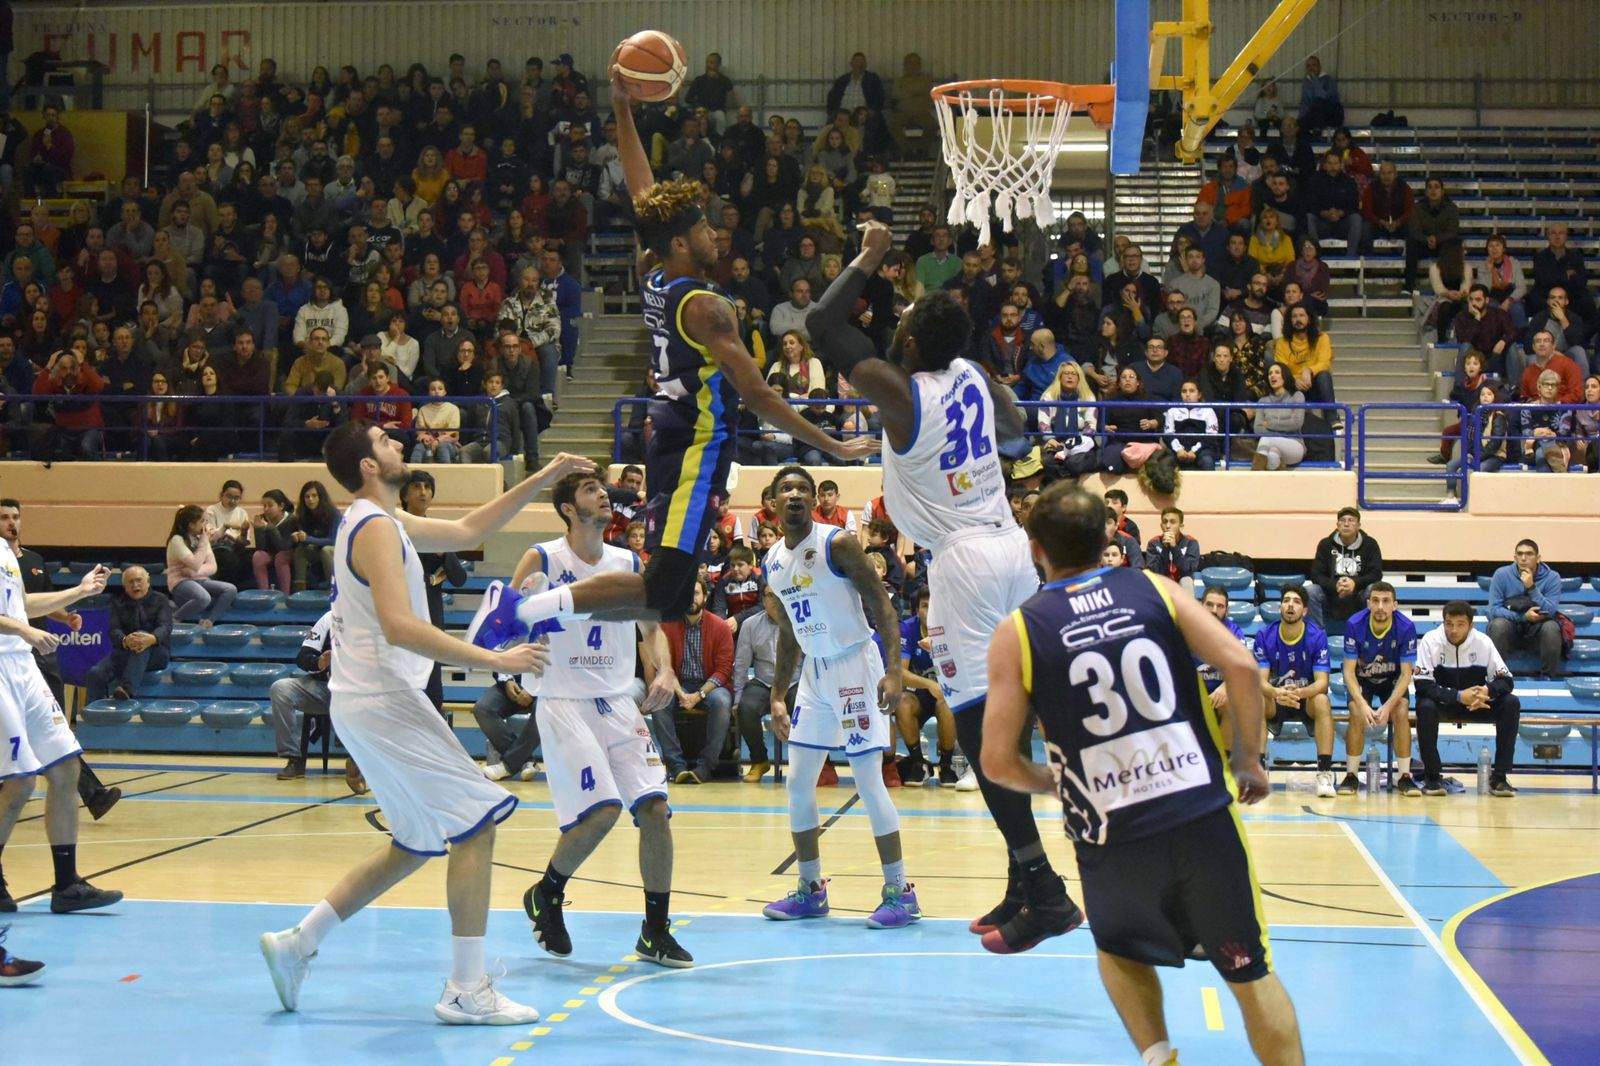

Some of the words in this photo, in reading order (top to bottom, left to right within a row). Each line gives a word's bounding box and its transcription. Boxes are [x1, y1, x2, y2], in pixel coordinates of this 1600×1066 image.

[939, 383, 992, 471] 32
[1068, 587, 1114, 614] MIKI
[1059, 607, 1136, 634] multimarcas
[56, 631, 102, 646] olten
[587, 625, 602, 650] 4
[580, 655, 614, 666] IMDECO
[1069, 637, 1177, 737] 30
[9, 736, 21, 761] 7
[580, 765, 596, 792] 4
[1093, 750, 1201, 793] Mercure
[1133, 778, 1174, 794] HOTELS
